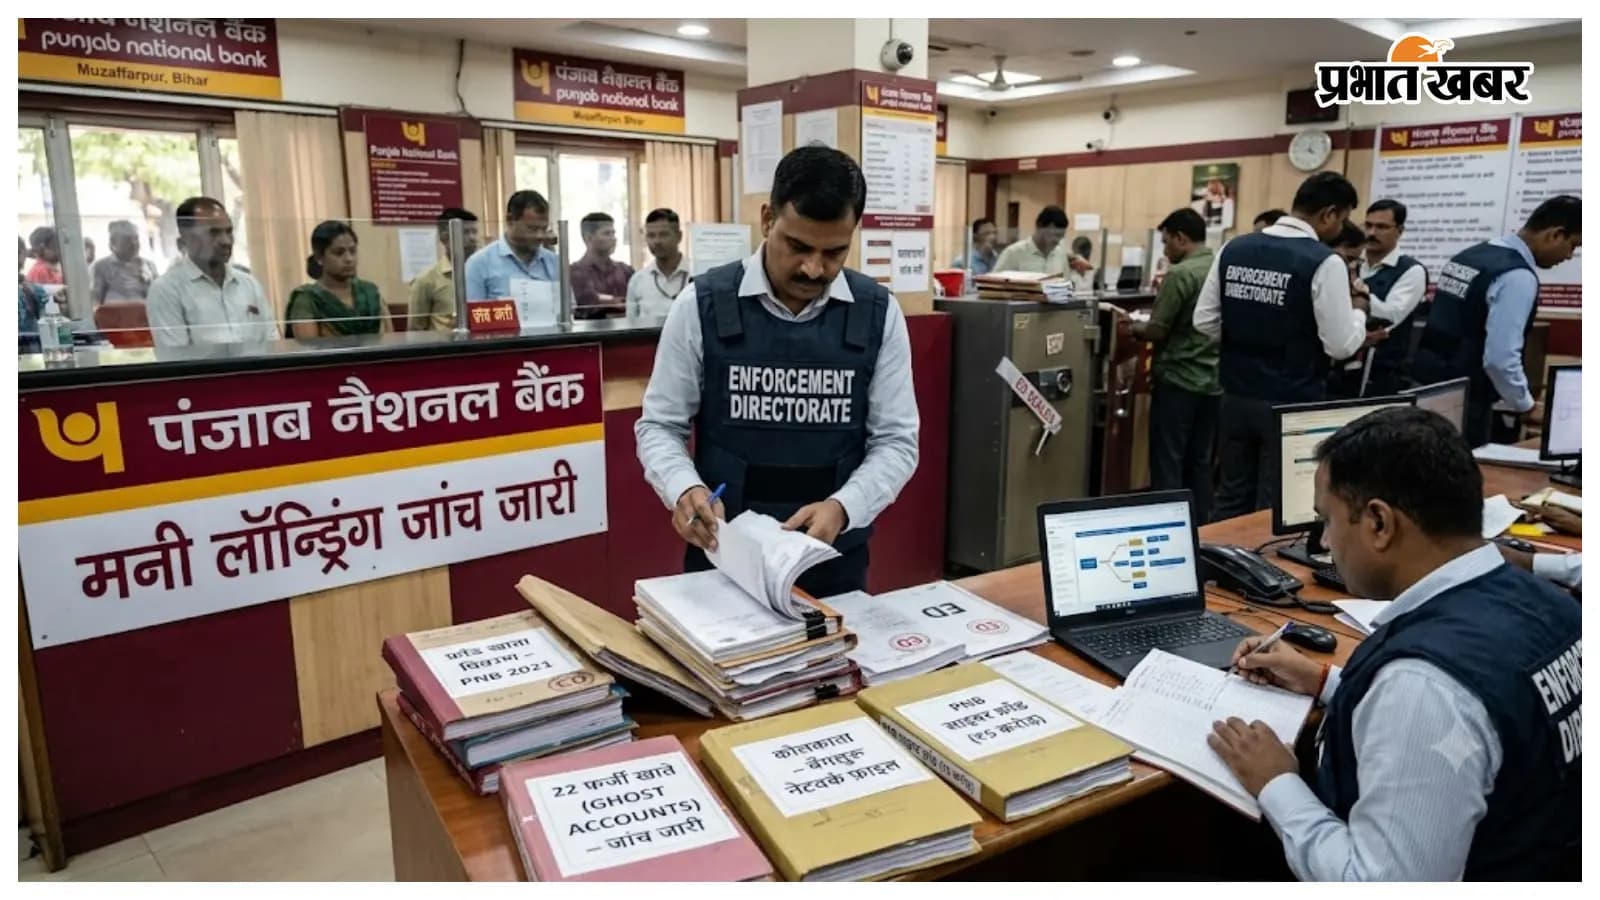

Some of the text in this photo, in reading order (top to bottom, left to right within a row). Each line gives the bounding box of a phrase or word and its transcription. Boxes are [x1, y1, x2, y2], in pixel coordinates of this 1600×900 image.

[41, 31, 267, 69] punjab national bank
[77, 63, 208, 87] Muzaffarpur, Bihar
[556, 88, 680, 111] punjab national bank
[1225, 265, 1292, 289] ENFORCEMENT
[728, 365, 855, 395] ENFORCEMENT
[148, 361, 585, 455] पंजाब नैशनल बैंक
[730, 394, 853, 423] DIRECTORATE
[75, 459, 578, 599] मनी लॉन्ड्रिंग जांच जारी
[460, 660, 553, 686] PNB 2021
[949, 696, 986, 711] PNB
[552, 763, 677, 798] 22 फर्जी खाते
[581, 785, 665, 814] (GHOST
[568, 798, 701, 836] ACCOUNTS)
[605, 830, 652, 850] जांच
[656, 817, 705, 840] जारी
